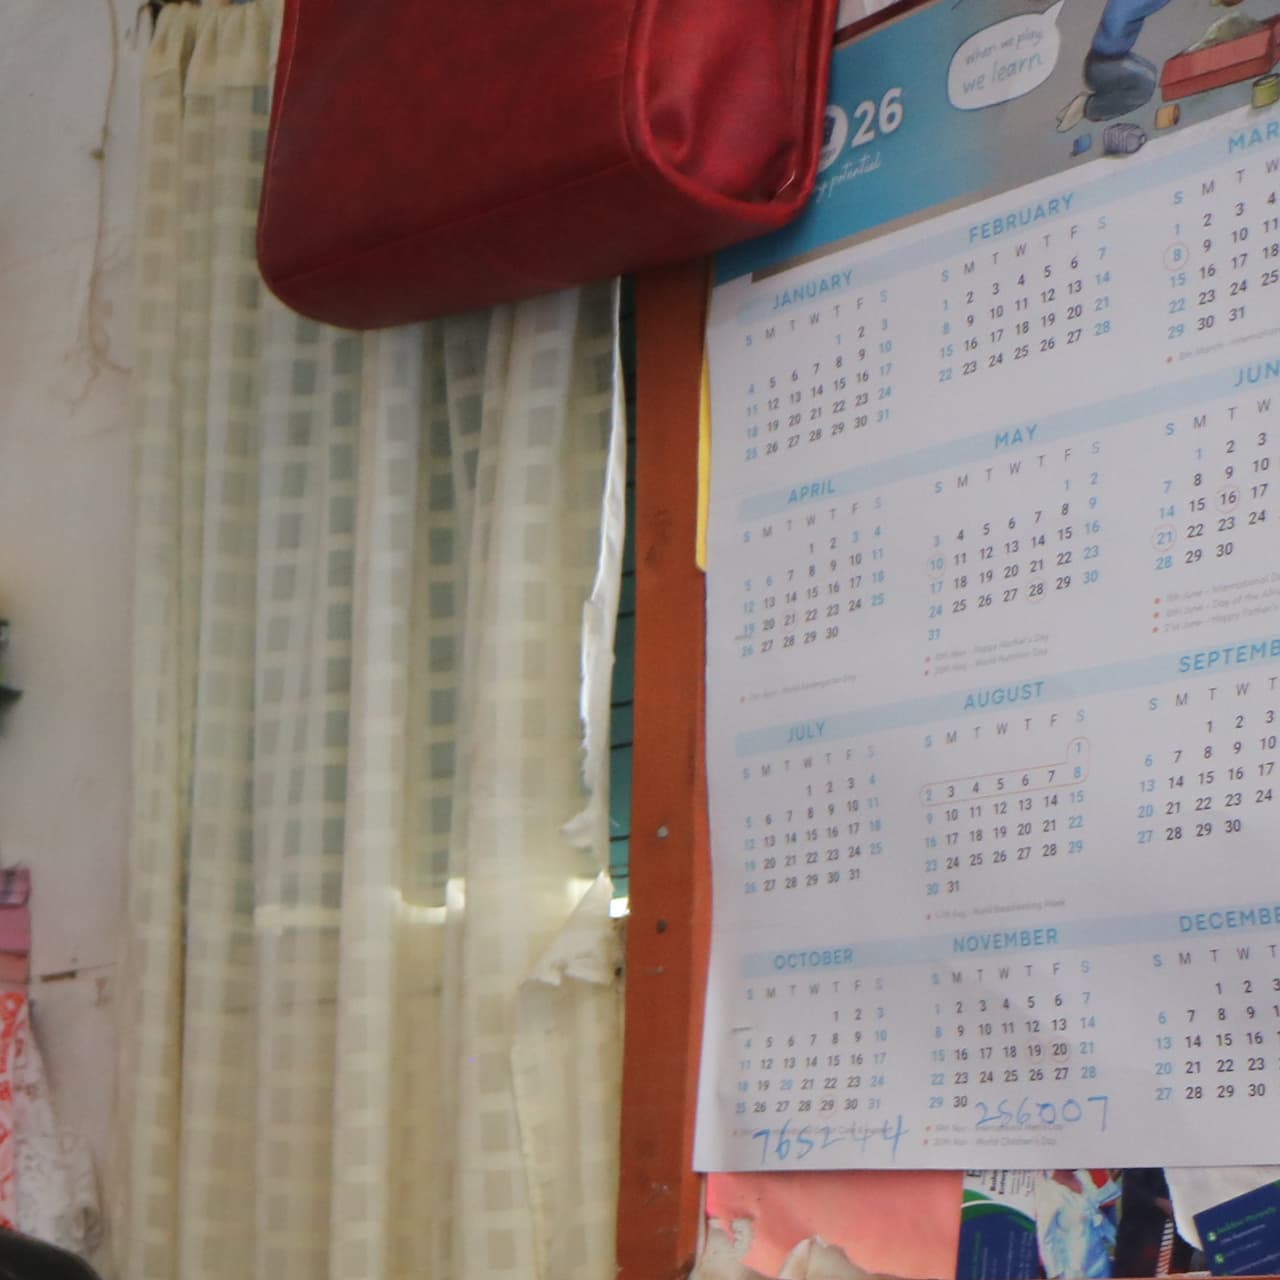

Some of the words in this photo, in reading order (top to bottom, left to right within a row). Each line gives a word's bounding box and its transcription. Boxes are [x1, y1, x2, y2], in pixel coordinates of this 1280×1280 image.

[962, 75, 985, 95] we
[969, 192, 1074, 243] FEBRUARY
[1232, 227, 1248, 243] 10
[1264, 217, 1278, 232] 11
[1200, 264, 1216, 279] 16
[1232, 253, 1248, 269] 17
[1263, 243, 1279, 259] 18
[772, 270, 853, 310] JANUARY
[1041, 288, 1055, 303] 12
[1068, 280, 1082, 294] 13
[1199, 289, 1215, 305] 23
[1230, 280, 1247, 296] 24
[1262, 269, 1279, 286] 25
[965, 337, 978, 351] 16
[1016, 321, 1029, 335] 18
[1041, 313, 1055, 327] 19
[1067, 304, 1082, 320] 20
[1197, 315, 1215, 331] 30
[1229, 306, 1245, 322] 31
[963, 361, 977, 375] 23
[989, 352, 1003, 367] 24
[1014, 344, 1029, 360] 25
[1040, 337, 1056, 352] 26
[1067, 328, 1082, 344] 27
[811, 384, 823, 397] 14
[834, 377, 846, 390] 15
[857, 370, 869, 383] 16
[856, 393, 868, 407] 23
[809, 428, 822, 442] 28
[854, 415, 868, 429] 30
[994, 424, 1038, 449] MAY
[1194, 473, 1202, 486] 8
[1253, 458, 1269, 472] 10
[787, 479, 835, 504] APRIL
[1190, 497, 1205, 512] 15
[1220, 491, 1236, 504] 16
[1251, 483, 1268, 498] 17
[1187, 523, 1204, 538] 22
[1218, 516, 1235, 532] 23
[1249, 510, 1266, 525] 24
[980, 546, 993, 560] 12
[1005, 540, 1019, 553] 13
[1032, 534, 1045, 548] 14
[1058, 526, 1072, 540] 15
[1186, 549, 1202, 563] 29
[1216, 542, 1233, 557] 30
[850, 553, 862, 566] 10
[954, 576, 968, 589] 18
[979, 570, 993, 584] 19
[1004, 564, 1019, 579] 20
[1030, 559, 1043, 573] 21
[1057, 551, 1072, 566] 22
[786, 592, 797, 604] 14
[978, 594, 992, 608] 26
[1003, 588, 1018, 602] 27
[1029, 583, 1044, 597] 28
[1056, 576, 1071, 590] 29
[826, 603, 839, 617] 23
[849, 599, 862, 611] 24
[783, 635, 795, 648] 28
[804, 630, 817, 644] 29
[964, 681, 1045, 711] AUGUST
[787, 719, 825, 743] JULY
[1235, 715, 1244, 728] 2
[1261, 736, 1277, 750] 10
[1168, 776, 1184, 789] 14
[1198, 771, 1214, 784] 15
[1228, 767, 1244, 780] 16
[1258, 762, 1275, 776] 17
[1044, 794, 1058, 807] 14
[1166, 802, 1181, 815] 21
[1195, 797, 1212, 811] 22
[1225, 793, 1242, 807] 23
[1256, 789, 1272, 803] 24
[785, 832, 797, 844] 14
[1017, 822, 1032, 836] 20
[1043, 819, 1055, 832] 21
[1166, 826, 1182, 840] 28
[1196, 823, 1212, 837] 29
[1225, 819, 1241, 833] 30
[806, 851, 818, 864] 22
[827, 848, 839, 861] 23
[848, 845, 861, 858] 24
[946, 856, 959, 869] 24
[993, 850, 1007, 863] 26
[1042, 844, 1057, 857] 28
[785, 876, 797, 889] 28
[806, 874, 819, 887] 29
[952, 928, 1059, 953] NOVEMBER
[773, 948, 854, 970] OCTOBER
[1218, 1008, 1226, 1020] 8
[1246, 1006, 1256, 1019] 9
[1025, 1020, 1040, 1032] 12
[1052, 1018, 1067, 1031] 13
[1186, 1035, 1202, 1048] 14
[1216, 1033, 1232, 1046] 15
[1246, 1032, 1263, 1044] 16
[955, 1048, 968, 1061] 16
[1003, 1045, 1016, 1058] 18
[1028, 1044, 1042, 1056] 19
[1052, 1043, 1068, 1056] 20
[954, 1072, 968, 1084] 23
[980, 1071, 994, 1083] 24
[1004, 1069, 1018, 1082] 25
[1029, 1069, 1044, 1081] 26
[1054, 1067, 1069, 1080] 27
[1186, 1061, 1200, 1074] 21
[1217, 1059, 1234, 1072] 22
[1248, 1057, 1264, 1071] 23
[824, 1077, 838, 1089] 22
[846, 1076, 861, 1088] 23
[1186, 1086, 1202, 1099] 28
[1217, 1085, 1234, 1098] 29
[1248, 1083, 1266, 1096] 30
[753, 1102, 767, 1113] 26
[798, 1100, 812, 1112] 28
[820, 1099, 835, 1111] 29
[844, 1098, 858, 1110] 30
[953, 1096, 968, 1108] 30
